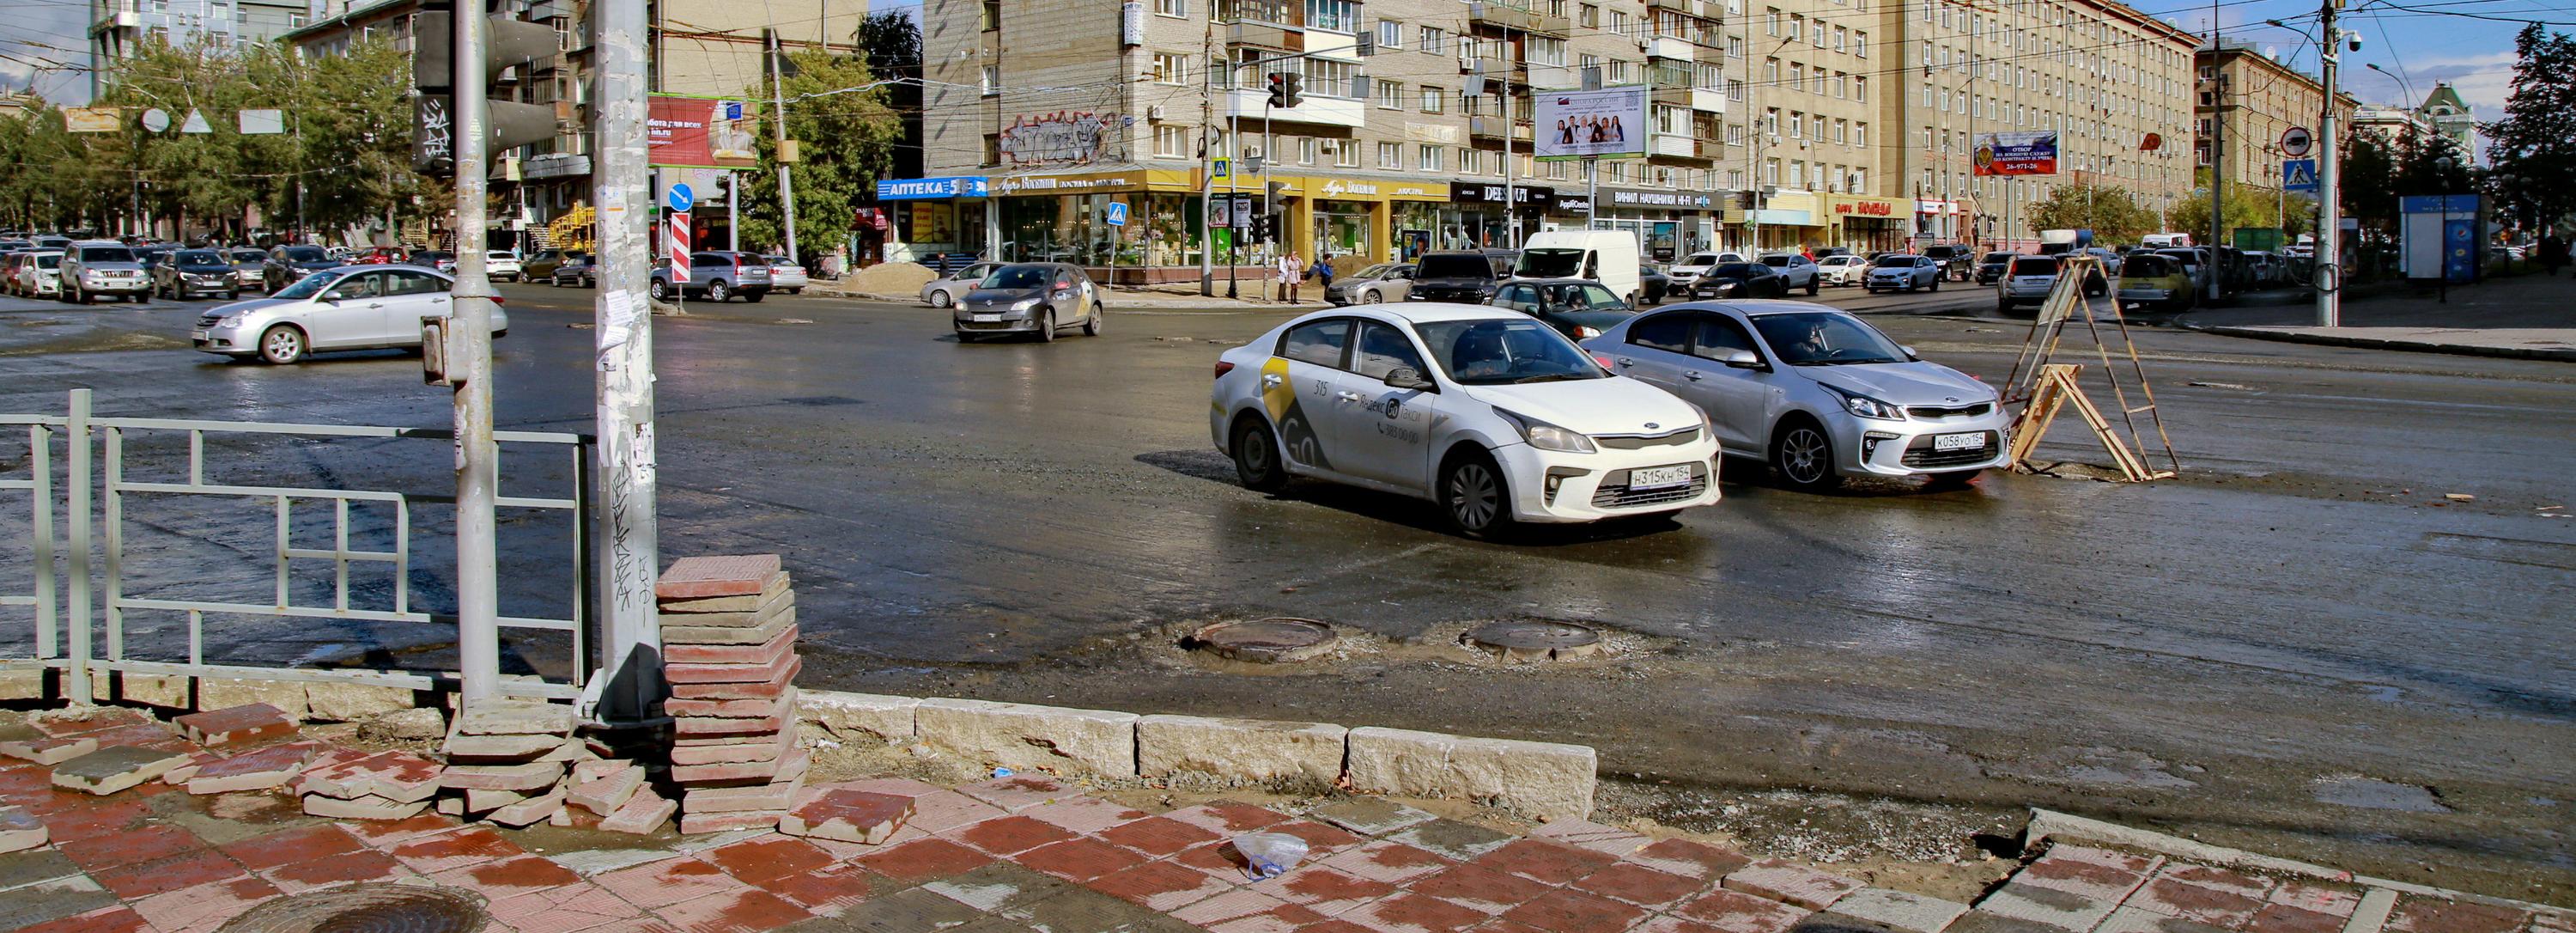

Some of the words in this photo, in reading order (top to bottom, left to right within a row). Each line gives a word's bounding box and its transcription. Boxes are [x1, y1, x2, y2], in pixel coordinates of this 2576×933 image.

[890, 182, 944, 196] АПТЕКА
[1559, 199, 1589, 210] AppleCente
[1614, 192, 1637, 204] ВИНИЛ
[1639, 193, 1675, 205] НАУШНИКИ
[1678, 195, 1690, 206] HI-FI
[1313, 379, 1328, 397] 315
[1359, 393, 1385, 414] Яндекс
[1387, 399, 1399, 416] Go
[1385, 424, 1398, 439] 383
[1399, 428, 1407, 442] 00
[1408, 430, 1419, 444] 00
[1634, 470, 1674, 485] Н315КН
[1675, 466, 1689, 478] 154
